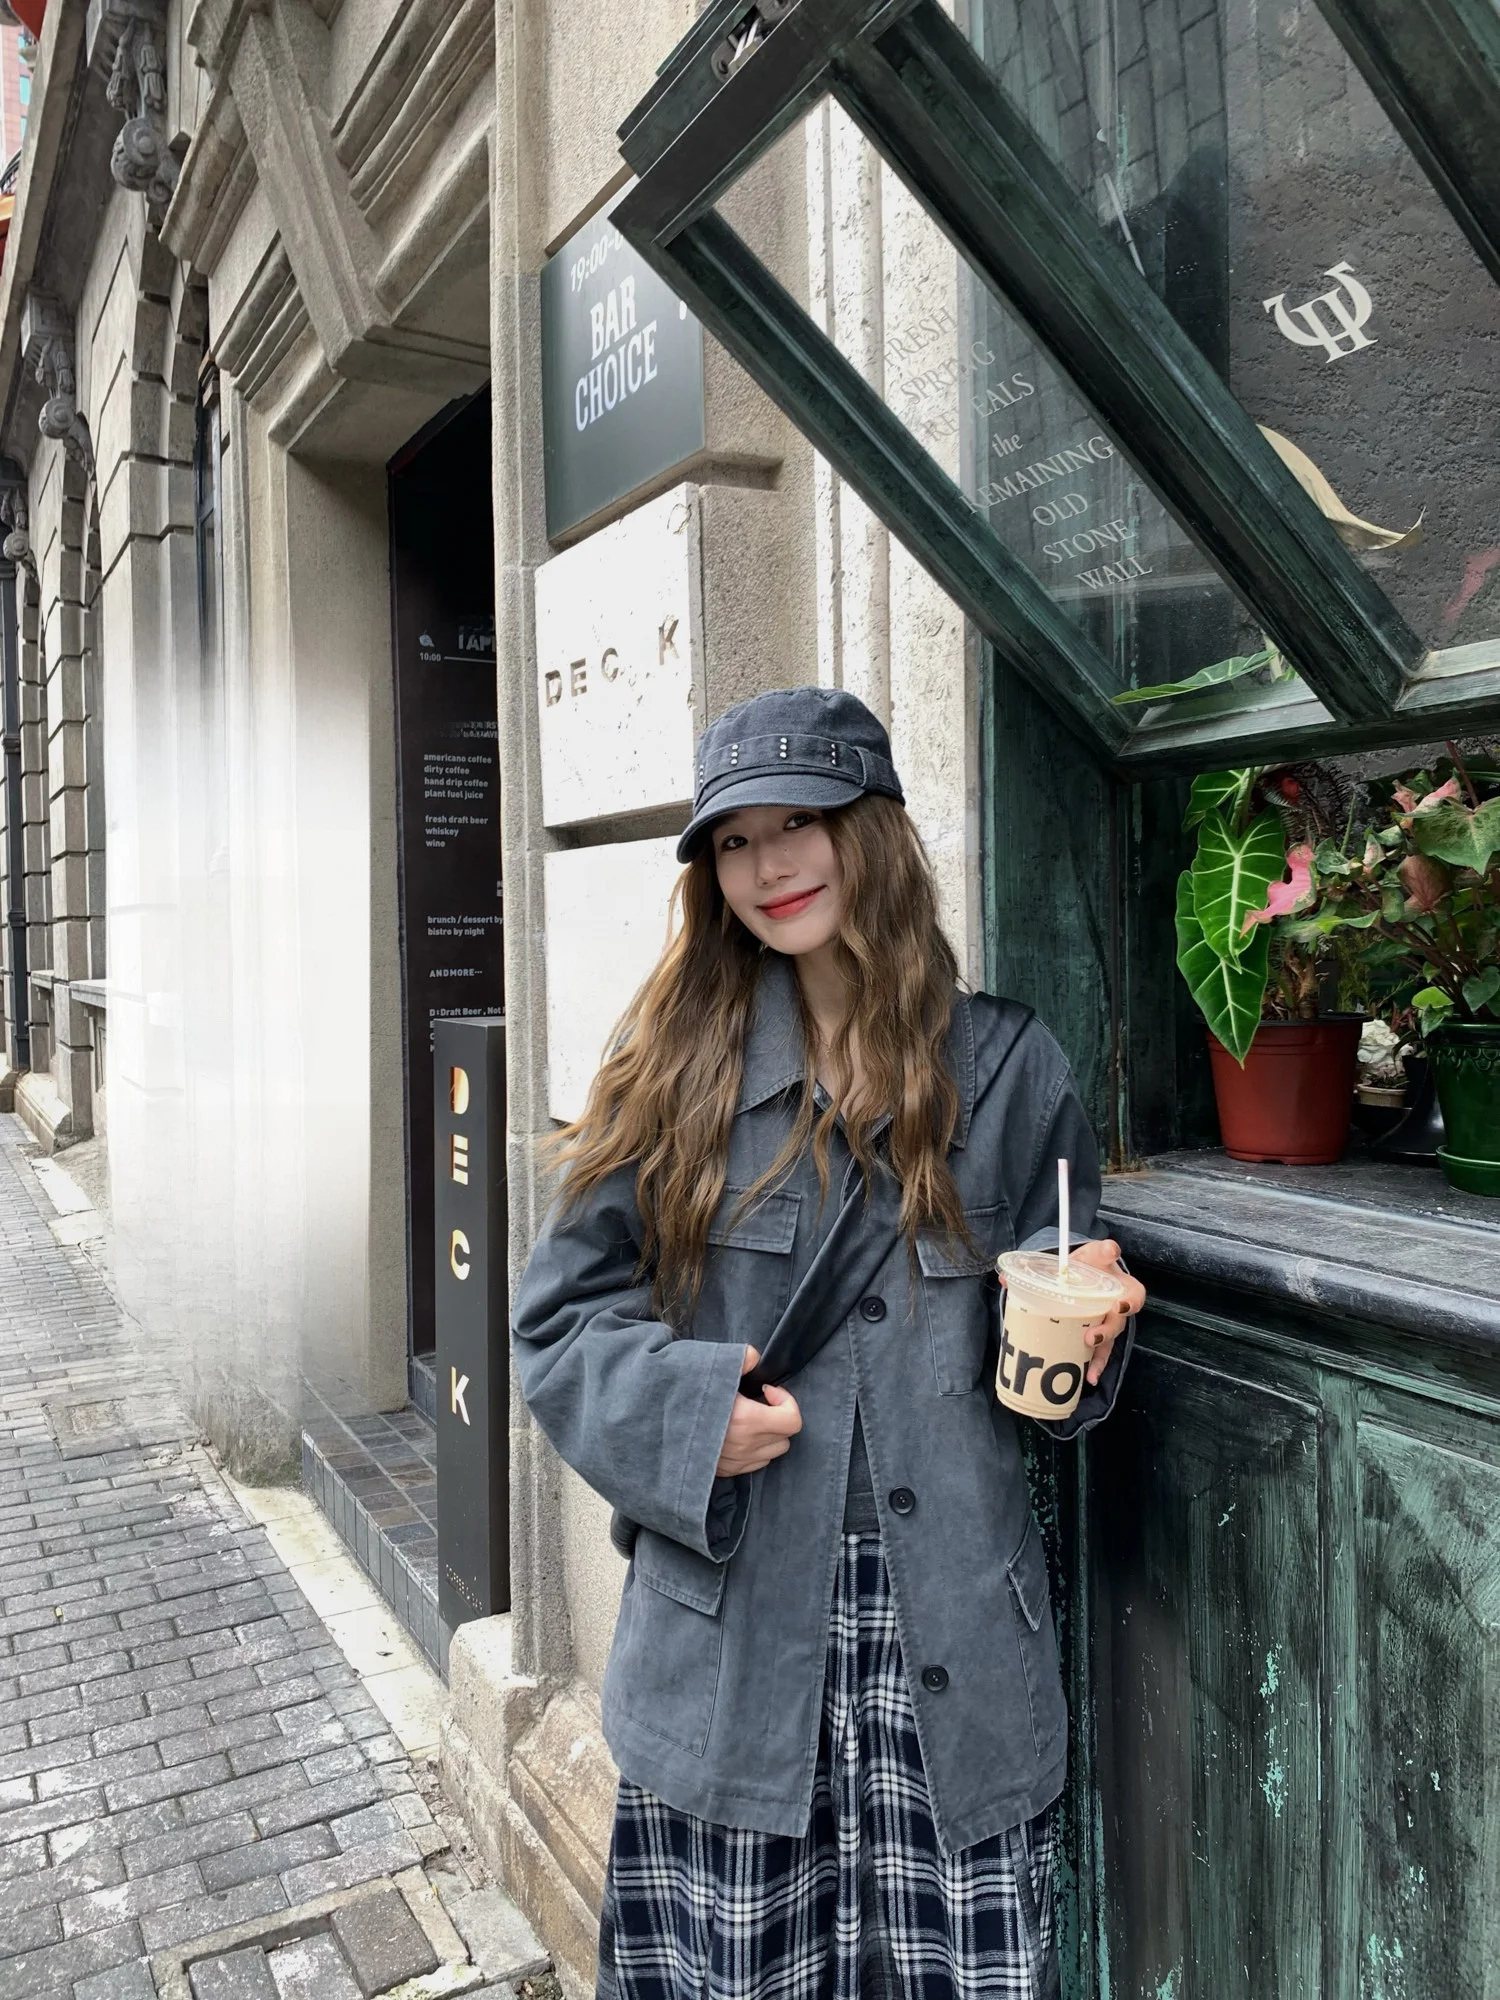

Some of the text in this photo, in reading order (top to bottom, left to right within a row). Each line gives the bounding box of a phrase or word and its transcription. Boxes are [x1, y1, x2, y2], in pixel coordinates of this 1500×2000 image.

[590, 274, 637, 361] BAR
[574, 319, 659, 432] CHOICE
[991, 433, 1024, 458] the
[1032, 492, 1089, 526] OLD
[1042, 518, 1137, 564] STONE
[1073, 555, 1154, 590] WALL
[419, 652, 442, 662] 10:00
[423, 753, 492, 764] americano coffee
[423, 764, 470, 775] dirty coffee
[424, 777, 489, 788] hand drip coffee
[424, 789, 484, 800] plant fuel juice
[425, 814, 489, 825] fresh draft beer
[425, 827, 459, 837] whiskey
[425, 839, 446, 848] wine
[427, 915, 456, 924] brunch
[463, 916, 493, 924] dessert
[427, 927, 485, 937] bistro by night
[999, 1327, 1085, 1405] tro
